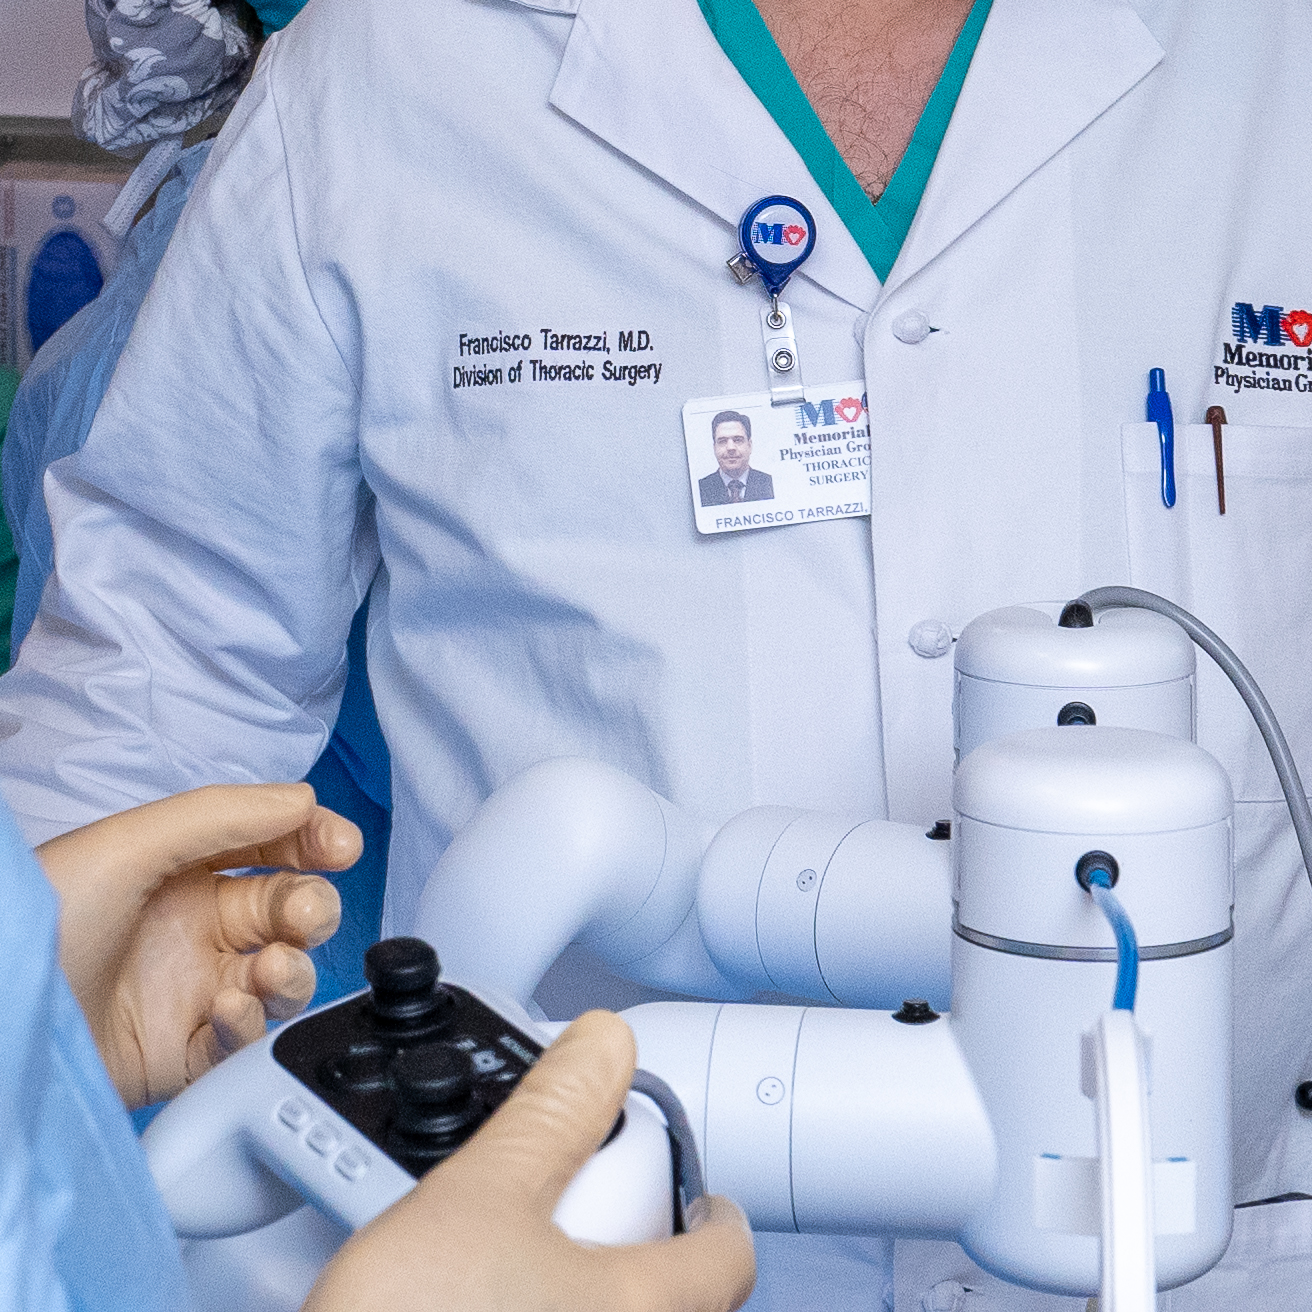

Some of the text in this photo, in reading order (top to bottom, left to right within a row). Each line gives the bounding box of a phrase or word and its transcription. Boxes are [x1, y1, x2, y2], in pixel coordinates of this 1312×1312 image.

[458, 328, 654, 357] Francisco Tarrazzi, M.D.
[453, 359, 663, 389] Division of Thoracic Surgery
[1213, 365, 1293, 394] Physician
[793, 424, 870, 446] Memorial
[779, 440, 871, 463] Physician Gro
[802, 455, 871, 473] THORACIC
[808, 470, 869, 486] SURGERY
[715, 510, 794, 529] FRANCISCO
